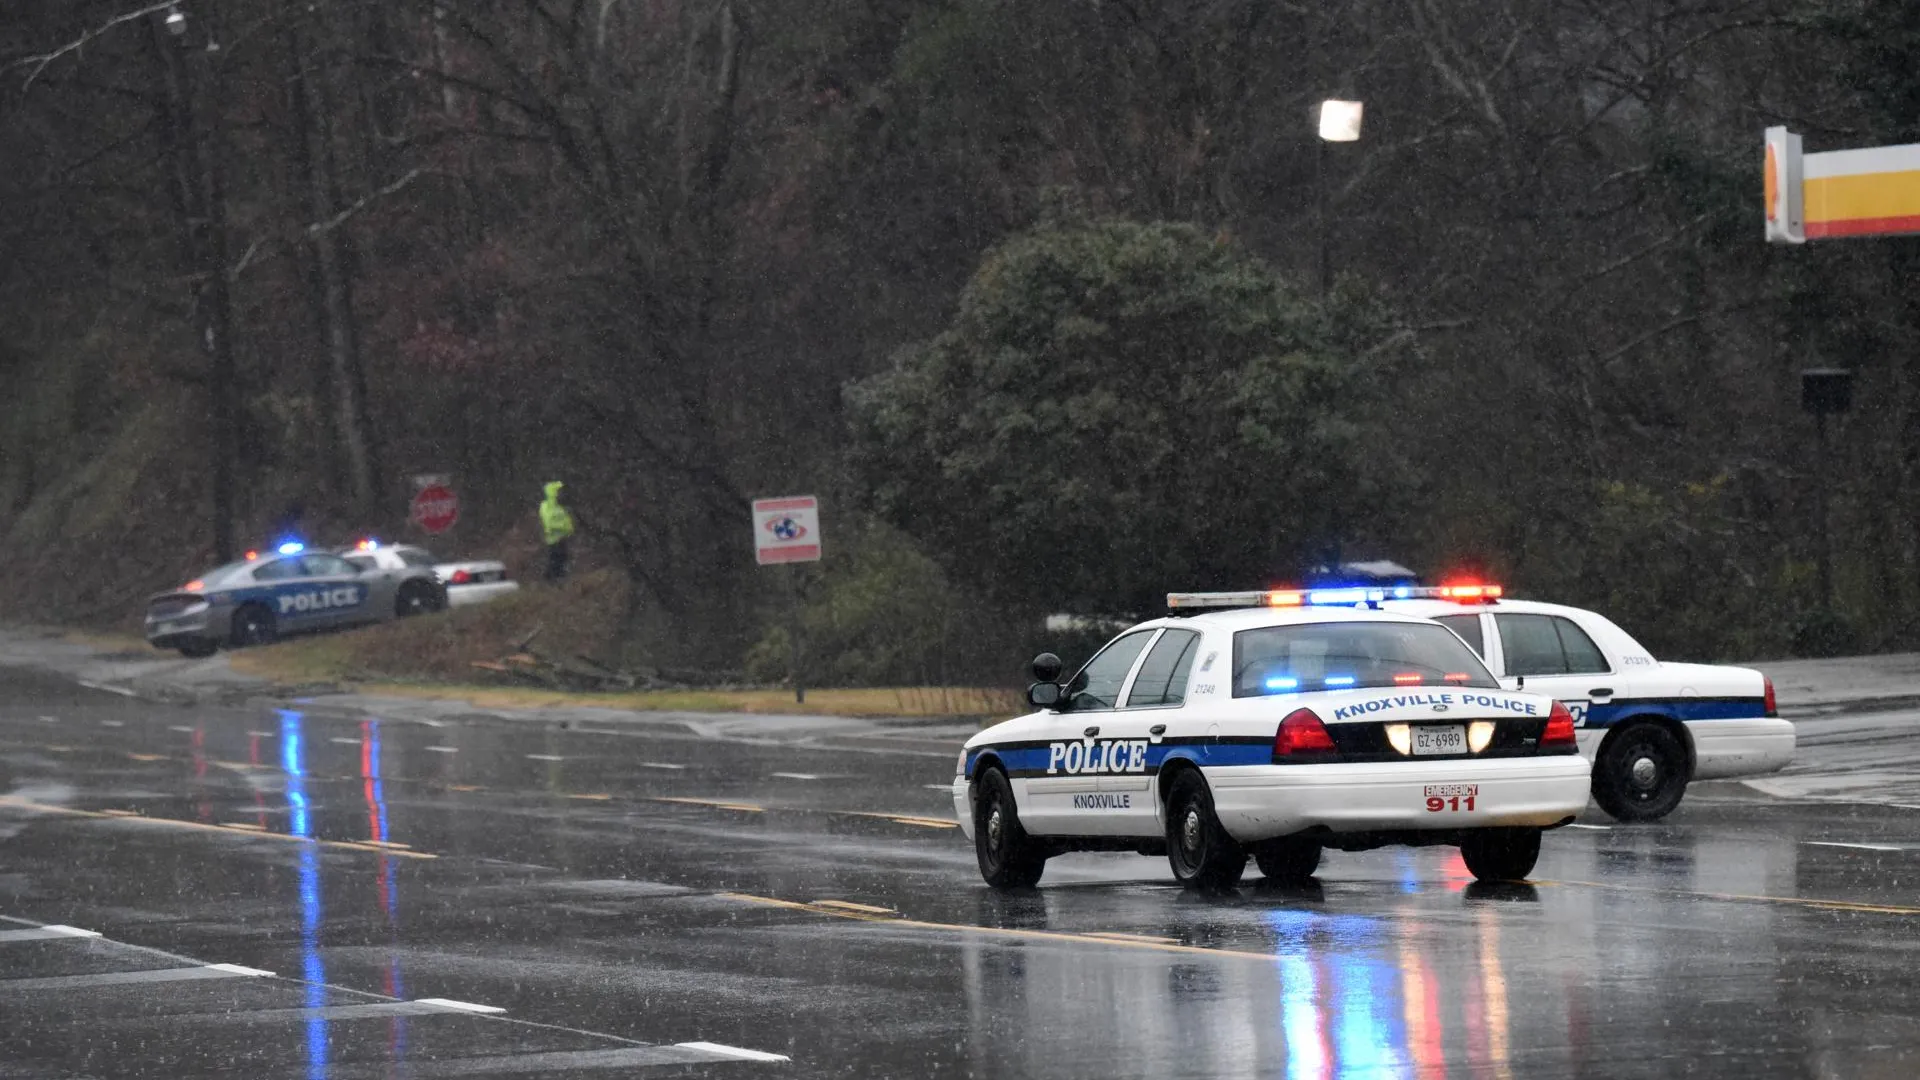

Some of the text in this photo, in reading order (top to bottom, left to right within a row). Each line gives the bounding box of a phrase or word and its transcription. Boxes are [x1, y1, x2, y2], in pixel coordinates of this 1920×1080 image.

[277, 587, 359, 613] POLICE
[1333, 694, 1454, 721] KNOXVILLE
[1462, 695, 1537, 716] POLICE
[1417, 733, 1460, 748] GZ-6989
[1047, 740, 1149, 775] POLICE
[1425, 784, 1478, 797] EMERGENCY
[1073, 794, 1131, 809] KNOXVILLE
[1426, 796, 1475, 812] 911
